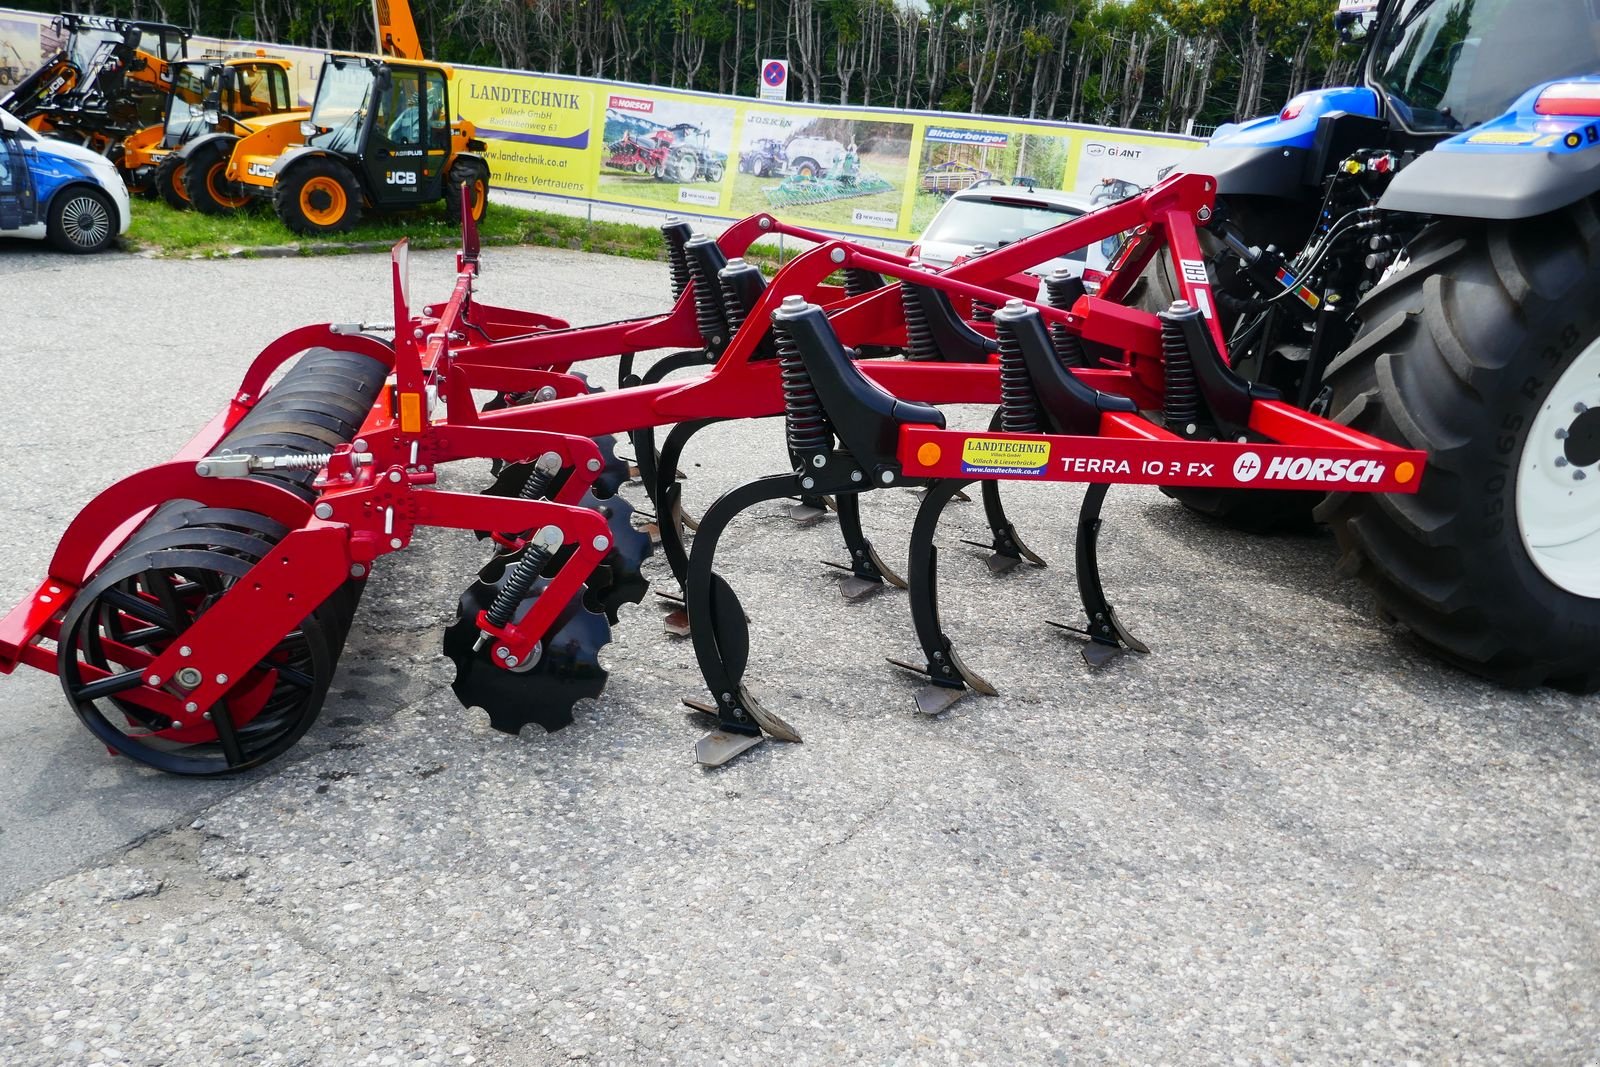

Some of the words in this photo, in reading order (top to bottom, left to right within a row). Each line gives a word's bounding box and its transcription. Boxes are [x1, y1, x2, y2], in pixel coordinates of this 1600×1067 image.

[470, 84, 580, 110] LANDTECHNIK
[618, 99, 652, 111] HORSCH
[500, 107, 526, 116] Villach
[527, 110, 553, 120] GmbH
[928, 129, 1006, 143] Binderberger
[386, 171, 417, 184] JCB
[504, 171, 528, 184] Ihres
[531, 175, 585, 191] Vertrauens
[1519, 375, 1545, 401] R
[1541, 322, 1581, 369] 38
[967, 441, 1047, 454] LANDTECHNIK
[966, 467, 1041, 475] www.landtechnik.co.at
[1187, 462, 1215, 477] FX
[1264, 456, 1386, 483] HORSCH
